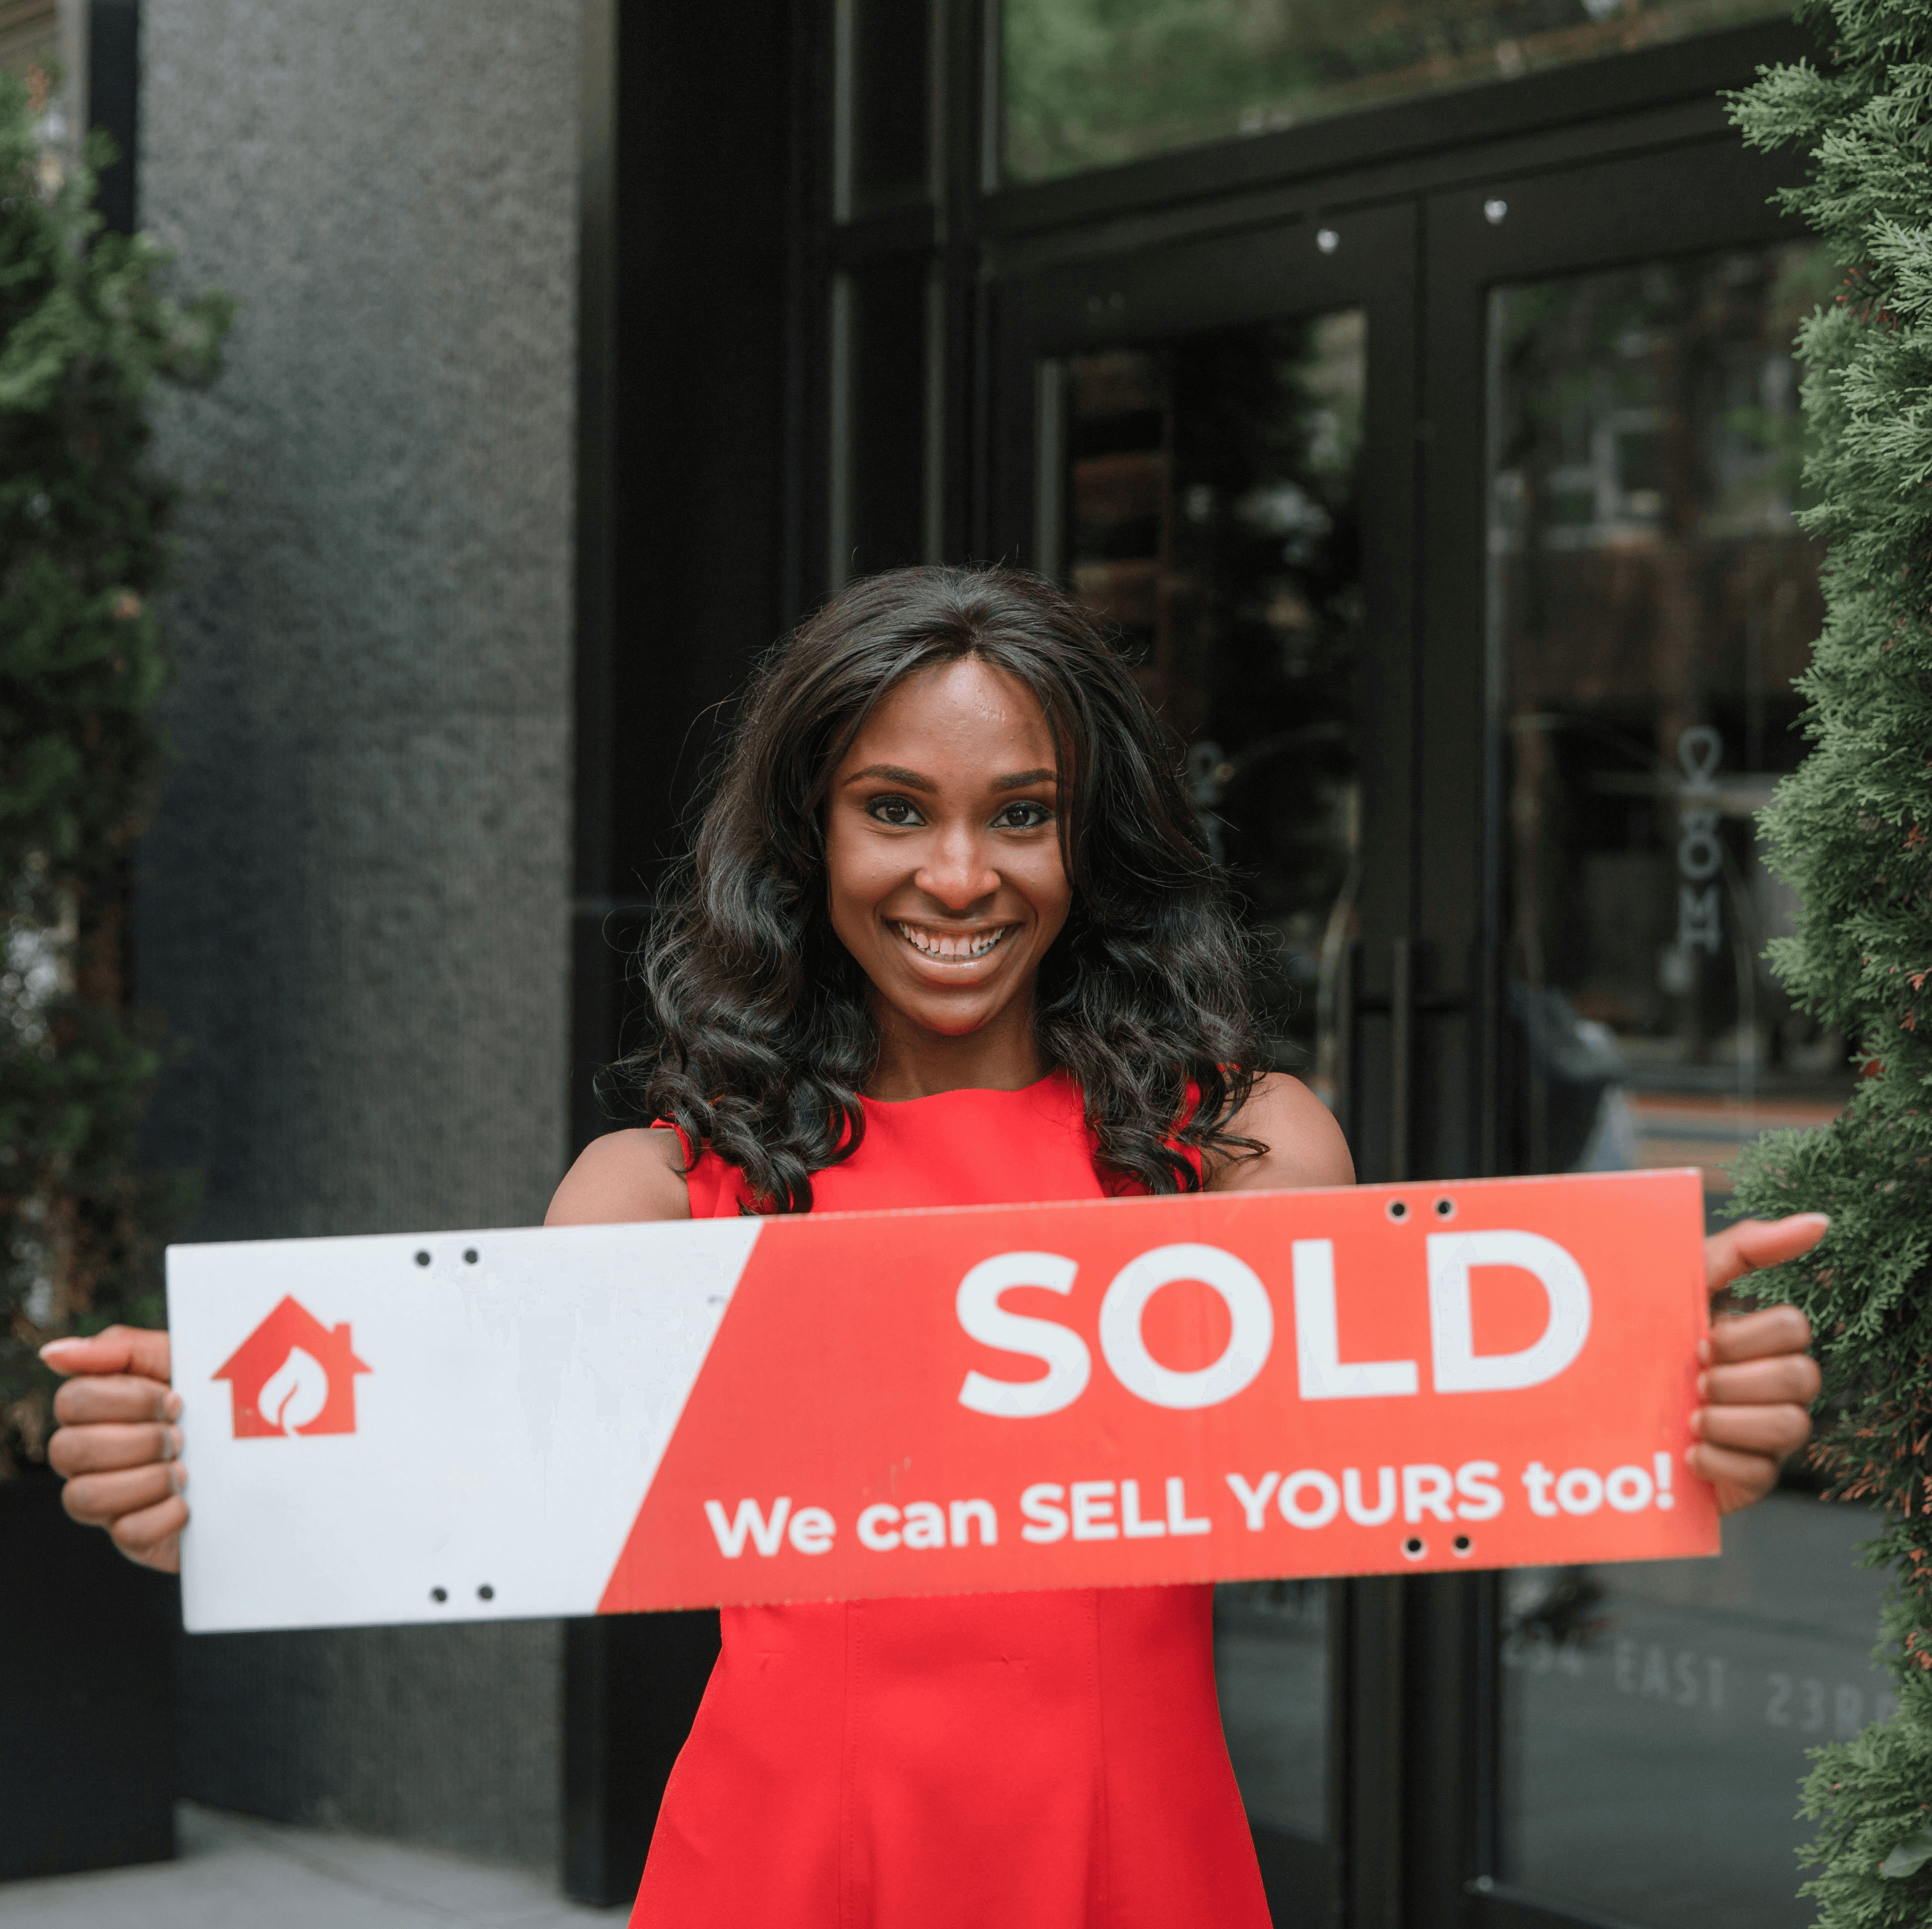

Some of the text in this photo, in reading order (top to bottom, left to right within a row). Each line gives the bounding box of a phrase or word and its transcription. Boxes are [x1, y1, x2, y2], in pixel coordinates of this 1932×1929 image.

[955, 1229, 1593, 1418] SOLD
[704, 1451, 1675, 1558] We can SELL YOURS too!
[1614, 1638, 1729, 1713] EAST
